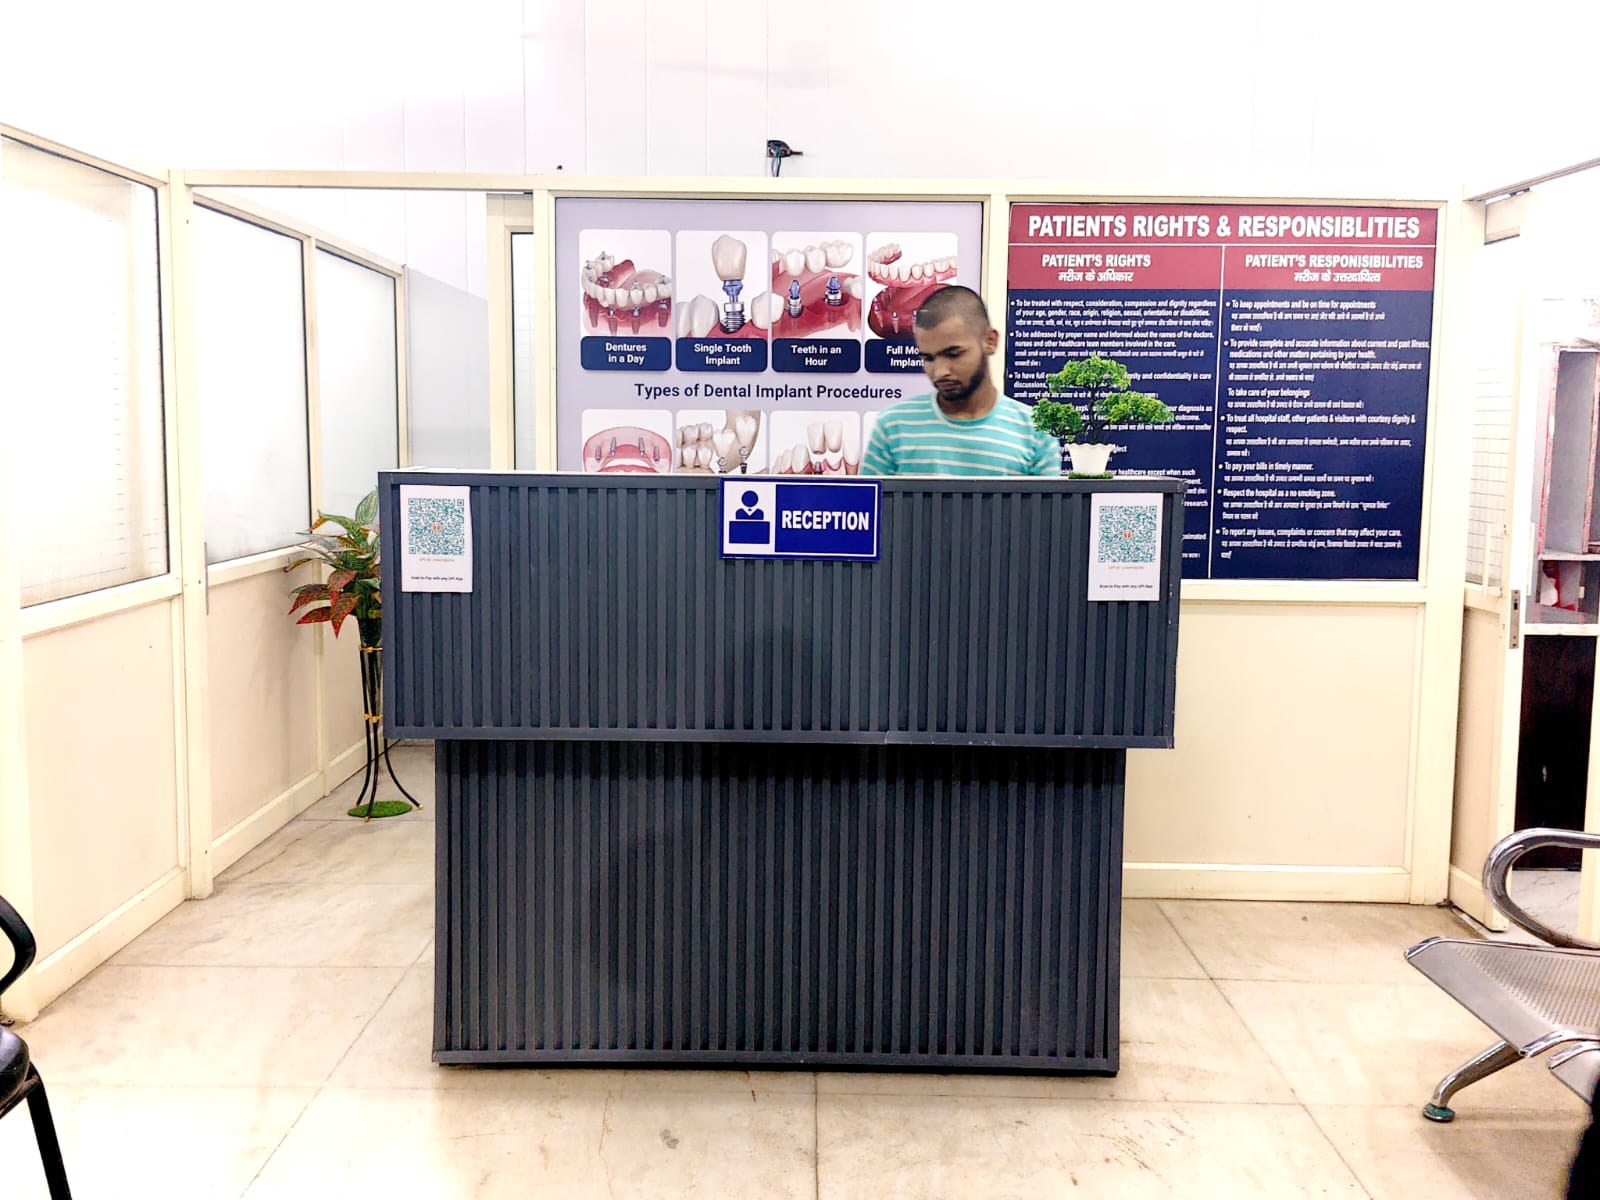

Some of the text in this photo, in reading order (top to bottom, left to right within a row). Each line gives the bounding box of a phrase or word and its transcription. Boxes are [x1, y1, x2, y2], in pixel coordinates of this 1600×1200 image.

[1029, 215, 1420, 238] PATIENTS RIGHTS & RESPONSIBLITIES
[1042, 254, 1151, 267] PATIENT'S RIGHTS
[1245, 254, 1306, 268] PATIENT'S
[1058, 268, 1134, 282] मरीज के अधिकार
[605, 342, 647, 352] Dentures
[694, 343, 752, 355] Single Tooth
[791, 345, 842, 354] Teeth in an
[886, 345, 903, 355] Full
[608, 354, 645, 365] in a Day
[705, 356, 741, 367] Implant
[805, 357, 828, 366] Hour
[890, 357, 925, 368] Implant
[634, 383, 902, 400] Types of Dental Implant Procedures
[781, 510, 870, 531] RECEPTION
